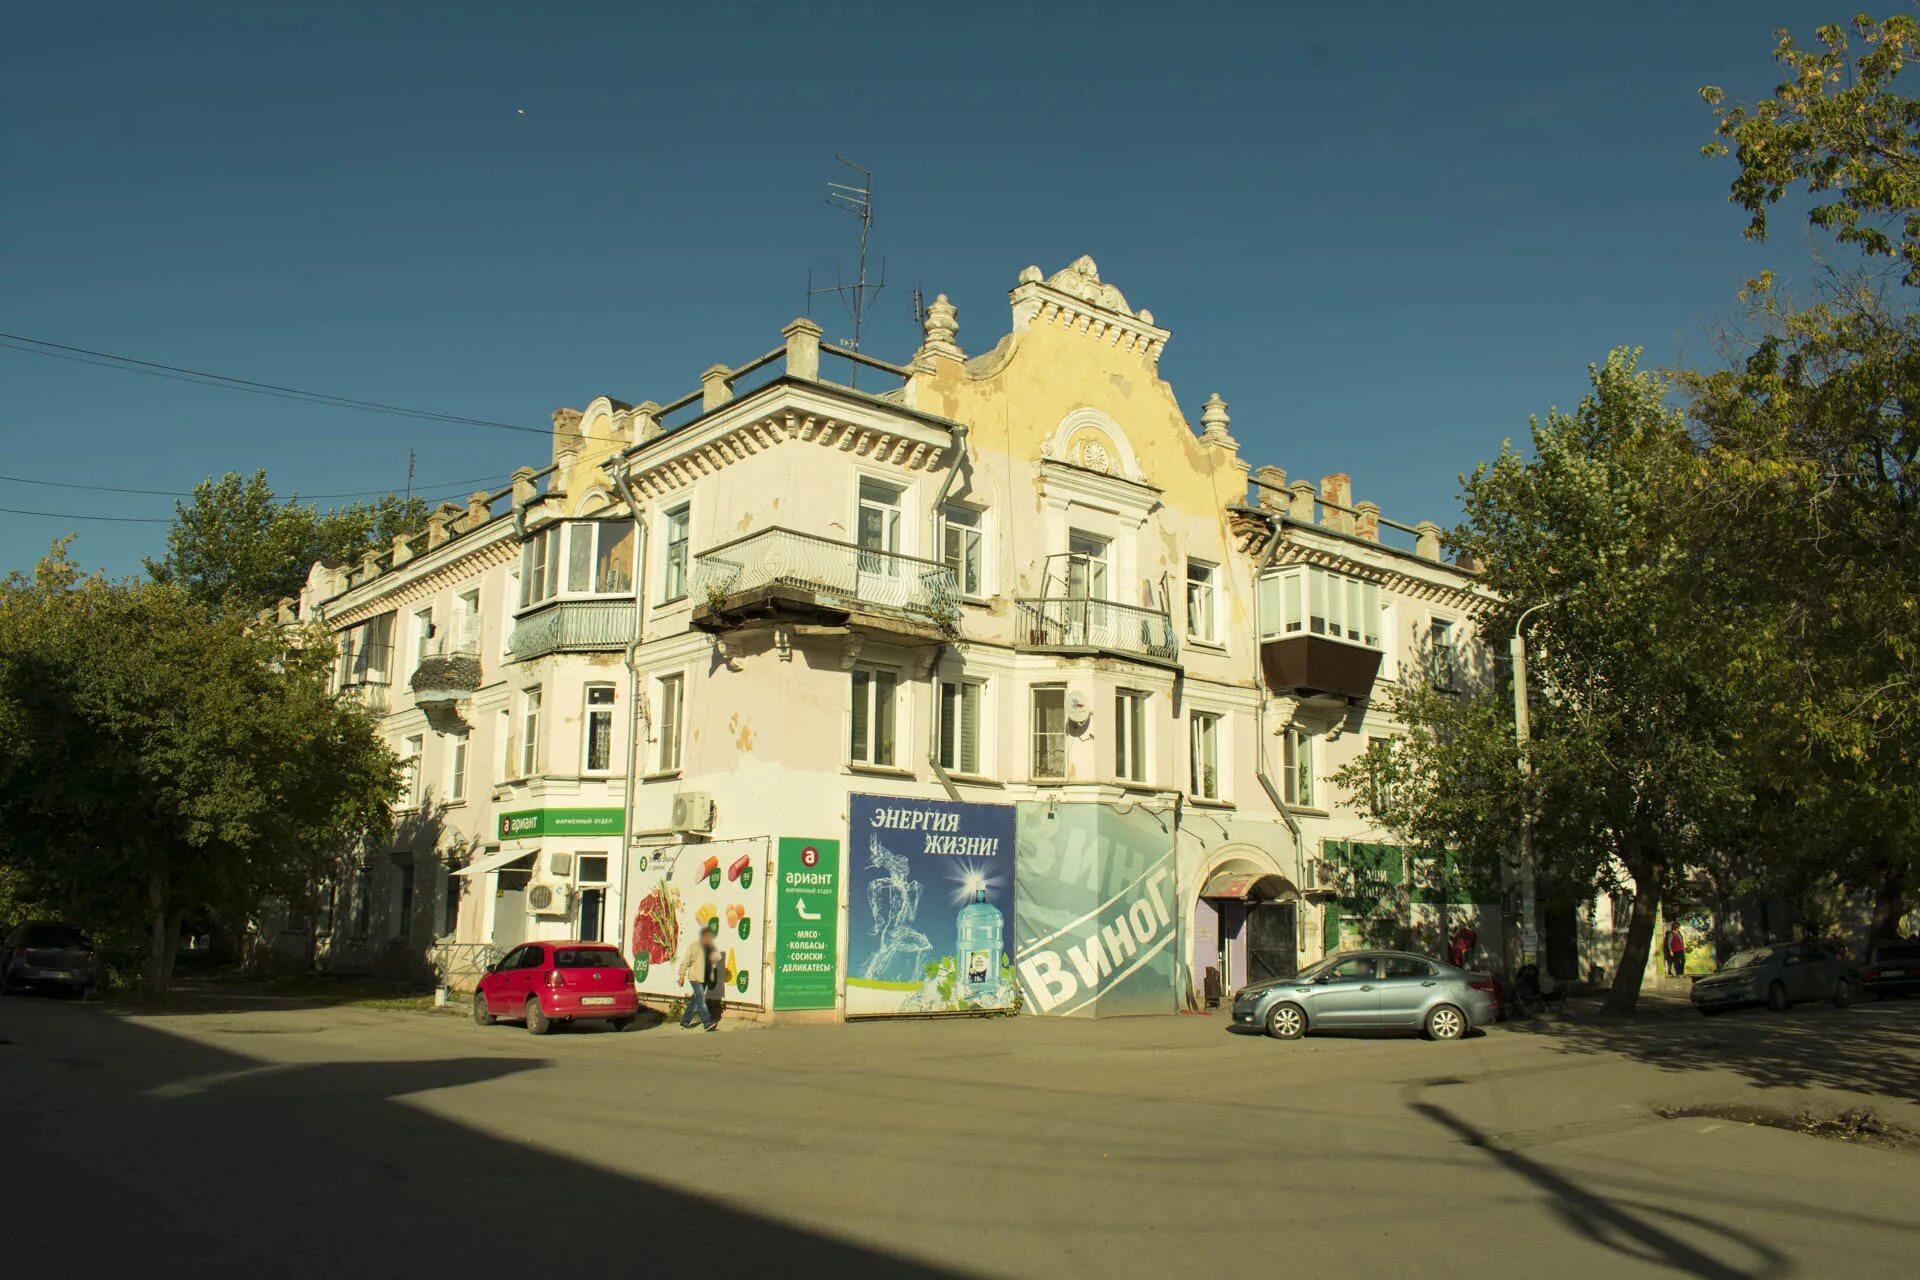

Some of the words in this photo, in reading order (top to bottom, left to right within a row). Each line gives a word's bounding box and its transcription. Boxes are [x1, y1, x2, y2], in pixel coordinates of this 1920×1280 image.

[511, 816, 538, 832] ариант
[871, 808, 960, 832] ЭНЕРГИЯ
[923, 834, 999, 856] ЖИЗНИ!
[785, 872, 833, 886] ариант
[797, 930, 818, 939] МЯСО
[789, 941, 825, 949] КОЛБАСЫ
[790, 952, 823, 961] СОСИСКИ
[636, 960, 648, 971] 209
[782, 963, 831, 973] ДЕЛИКАТЕСЫ
